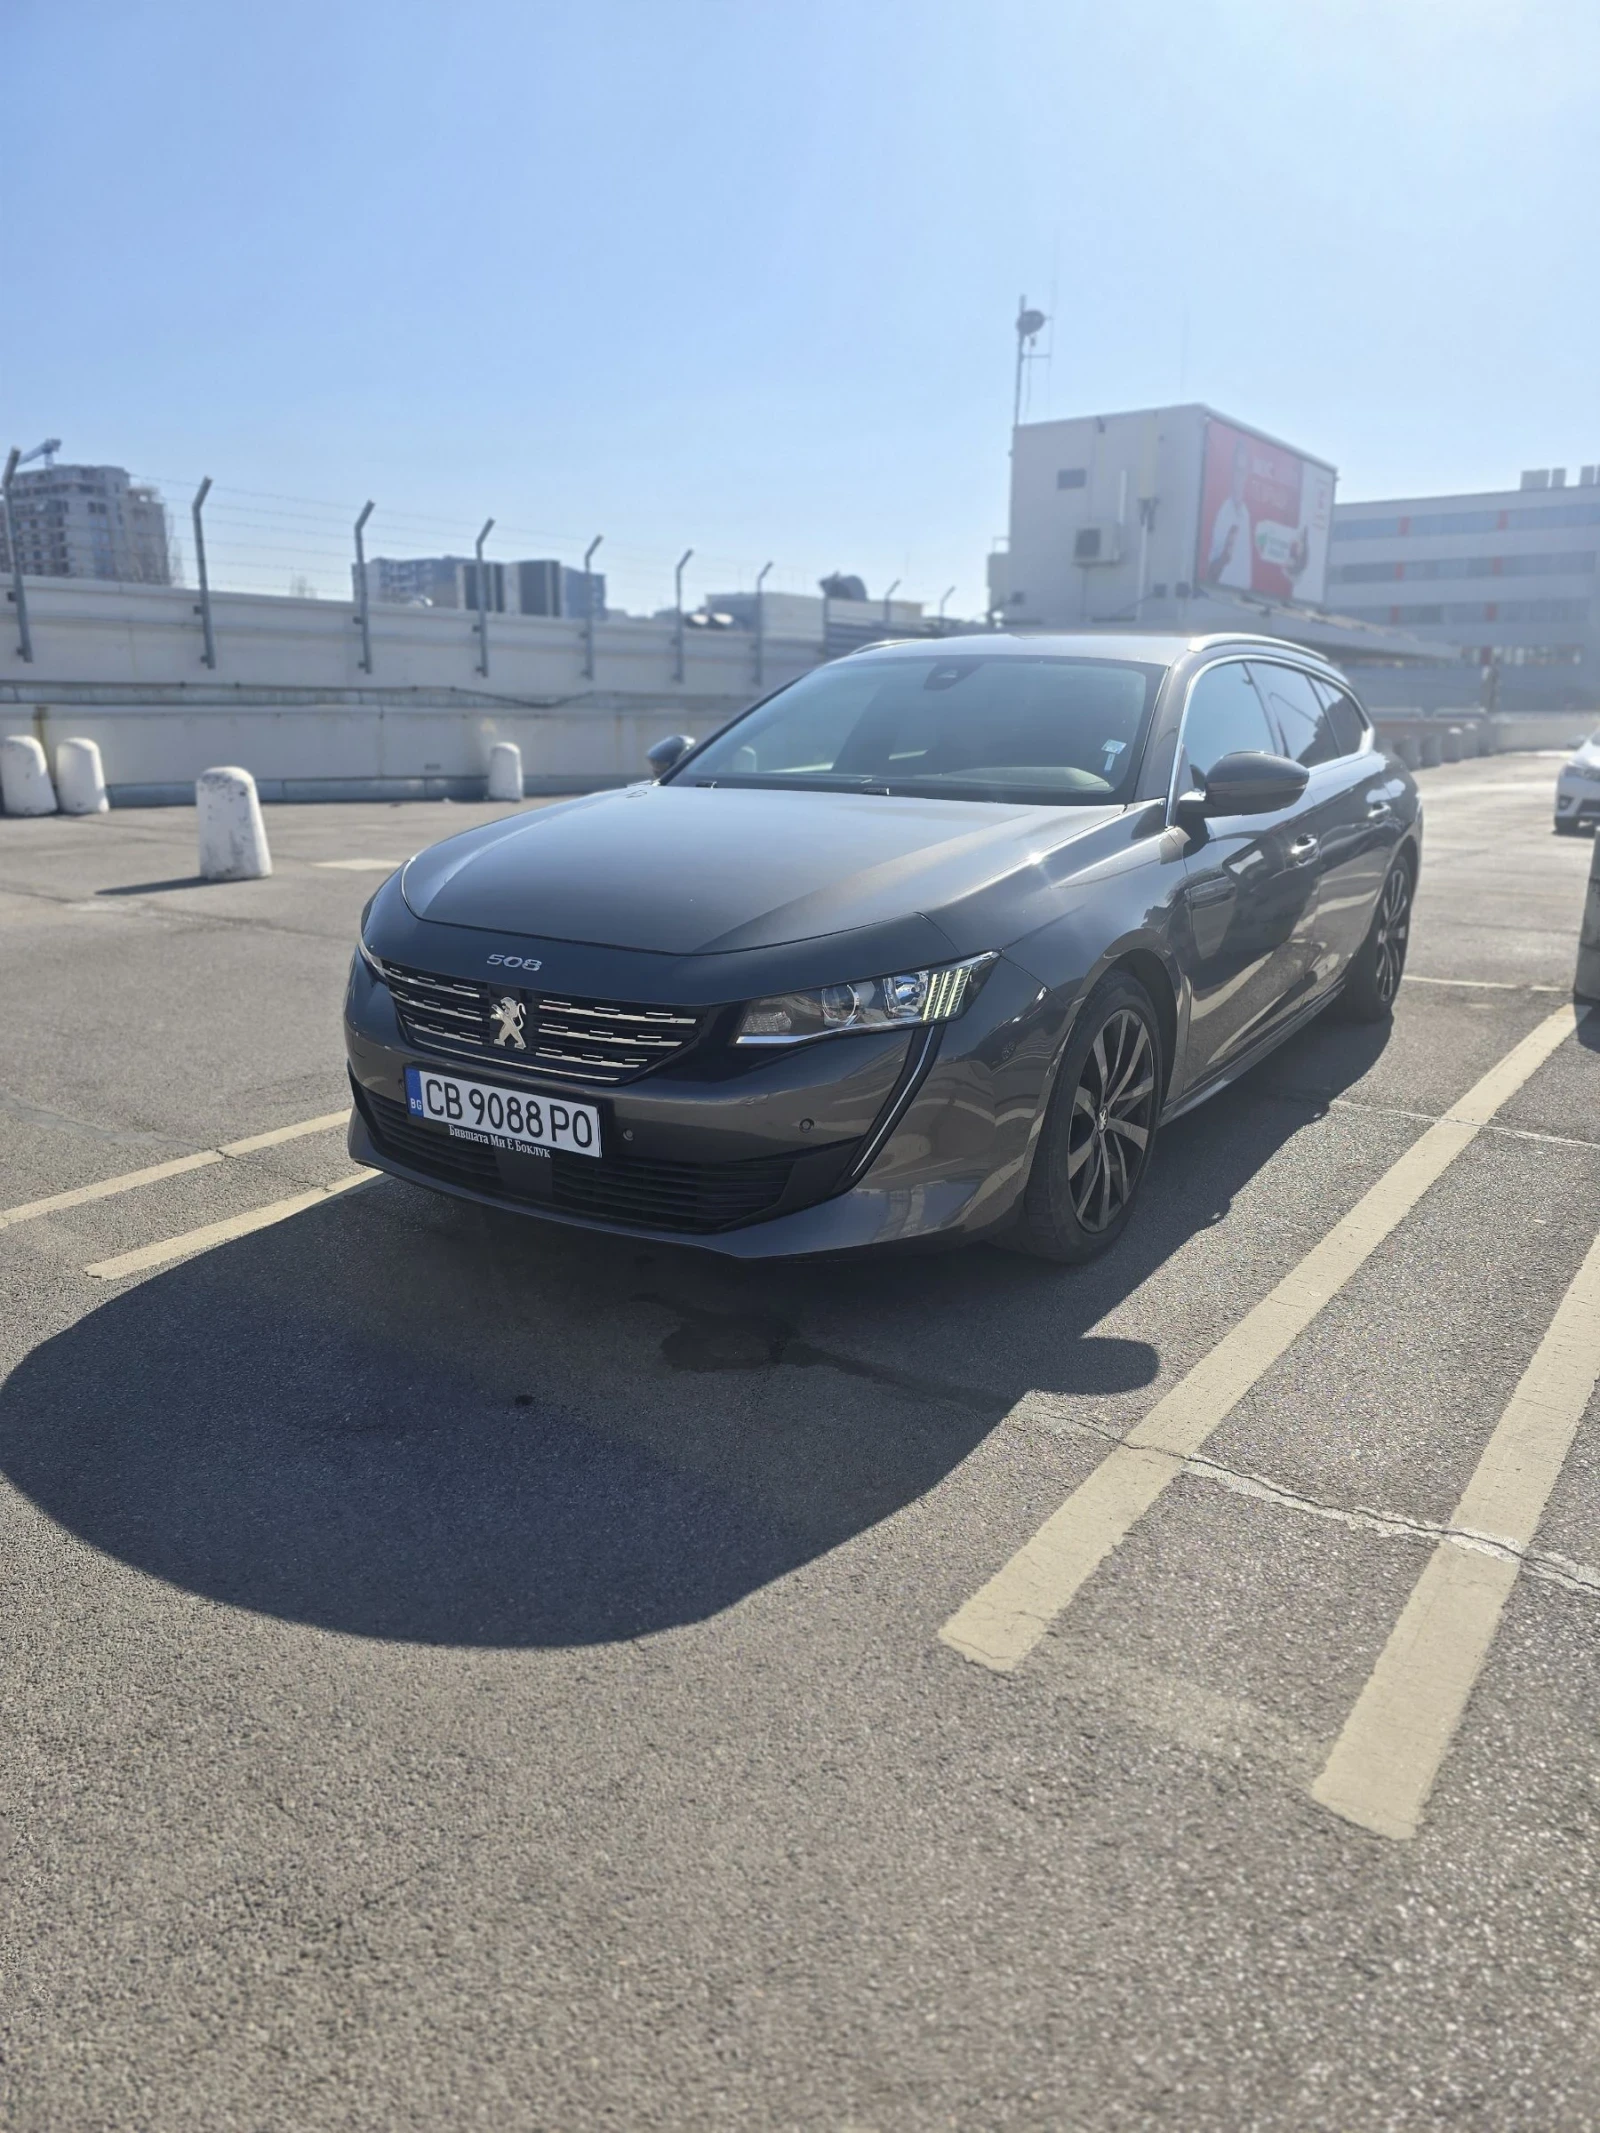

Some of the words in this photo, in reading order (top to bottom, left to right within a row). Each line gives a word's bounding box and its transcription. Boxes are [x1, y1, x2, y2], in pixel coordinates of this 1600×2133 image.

[486, 953, 542, 971] 508
[410, 1098, 422, 1111] BG
[426, 1079, 463, 1120] CB
[468, 1088, 544, 1138] 9088
[549, 1104, 592, 1148] PO
[448, 1124, 489, 1144] Бившата
[490, 1134, 505, 1148] Ми
[507, 1137, 514, 1150] Е
[514, 1140, 551, 1158] Боклук
